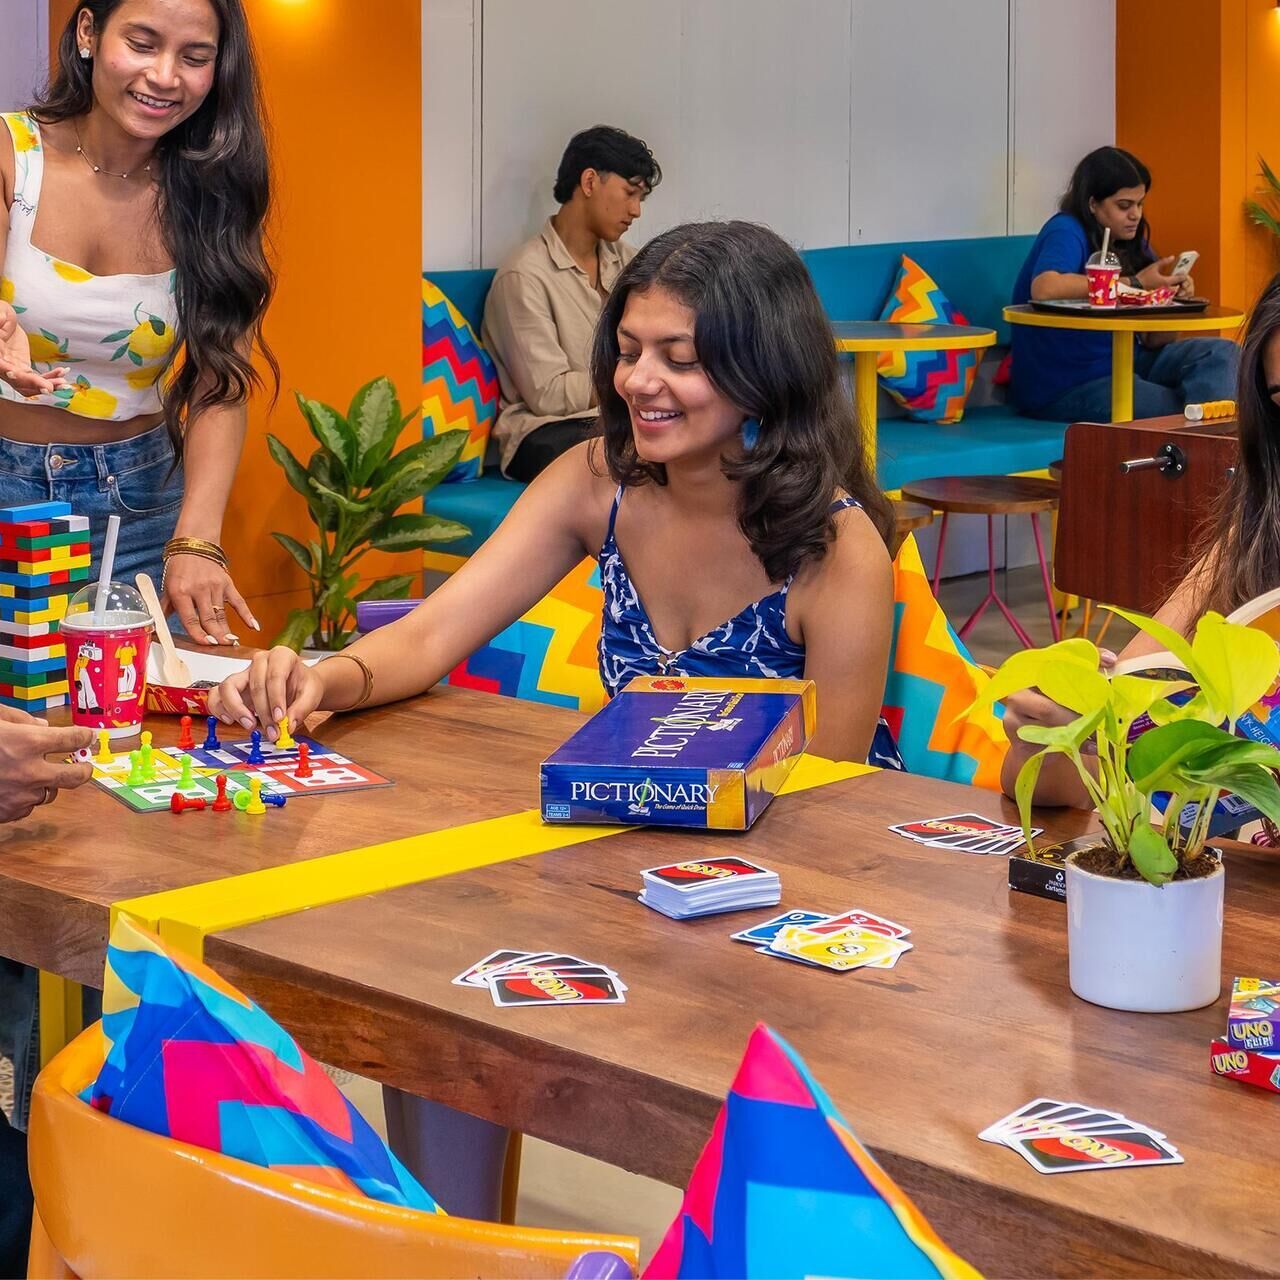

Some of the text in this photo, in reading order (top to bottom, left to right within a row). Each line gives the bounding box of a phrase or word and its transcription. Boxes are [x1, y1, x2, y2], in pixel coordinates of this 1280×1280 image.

[570, 781, 720, 804] PICTIONARY
[1230, 1020, 1274, 1042] UNO
[1211, 1050, 1248, 1076] UNO
